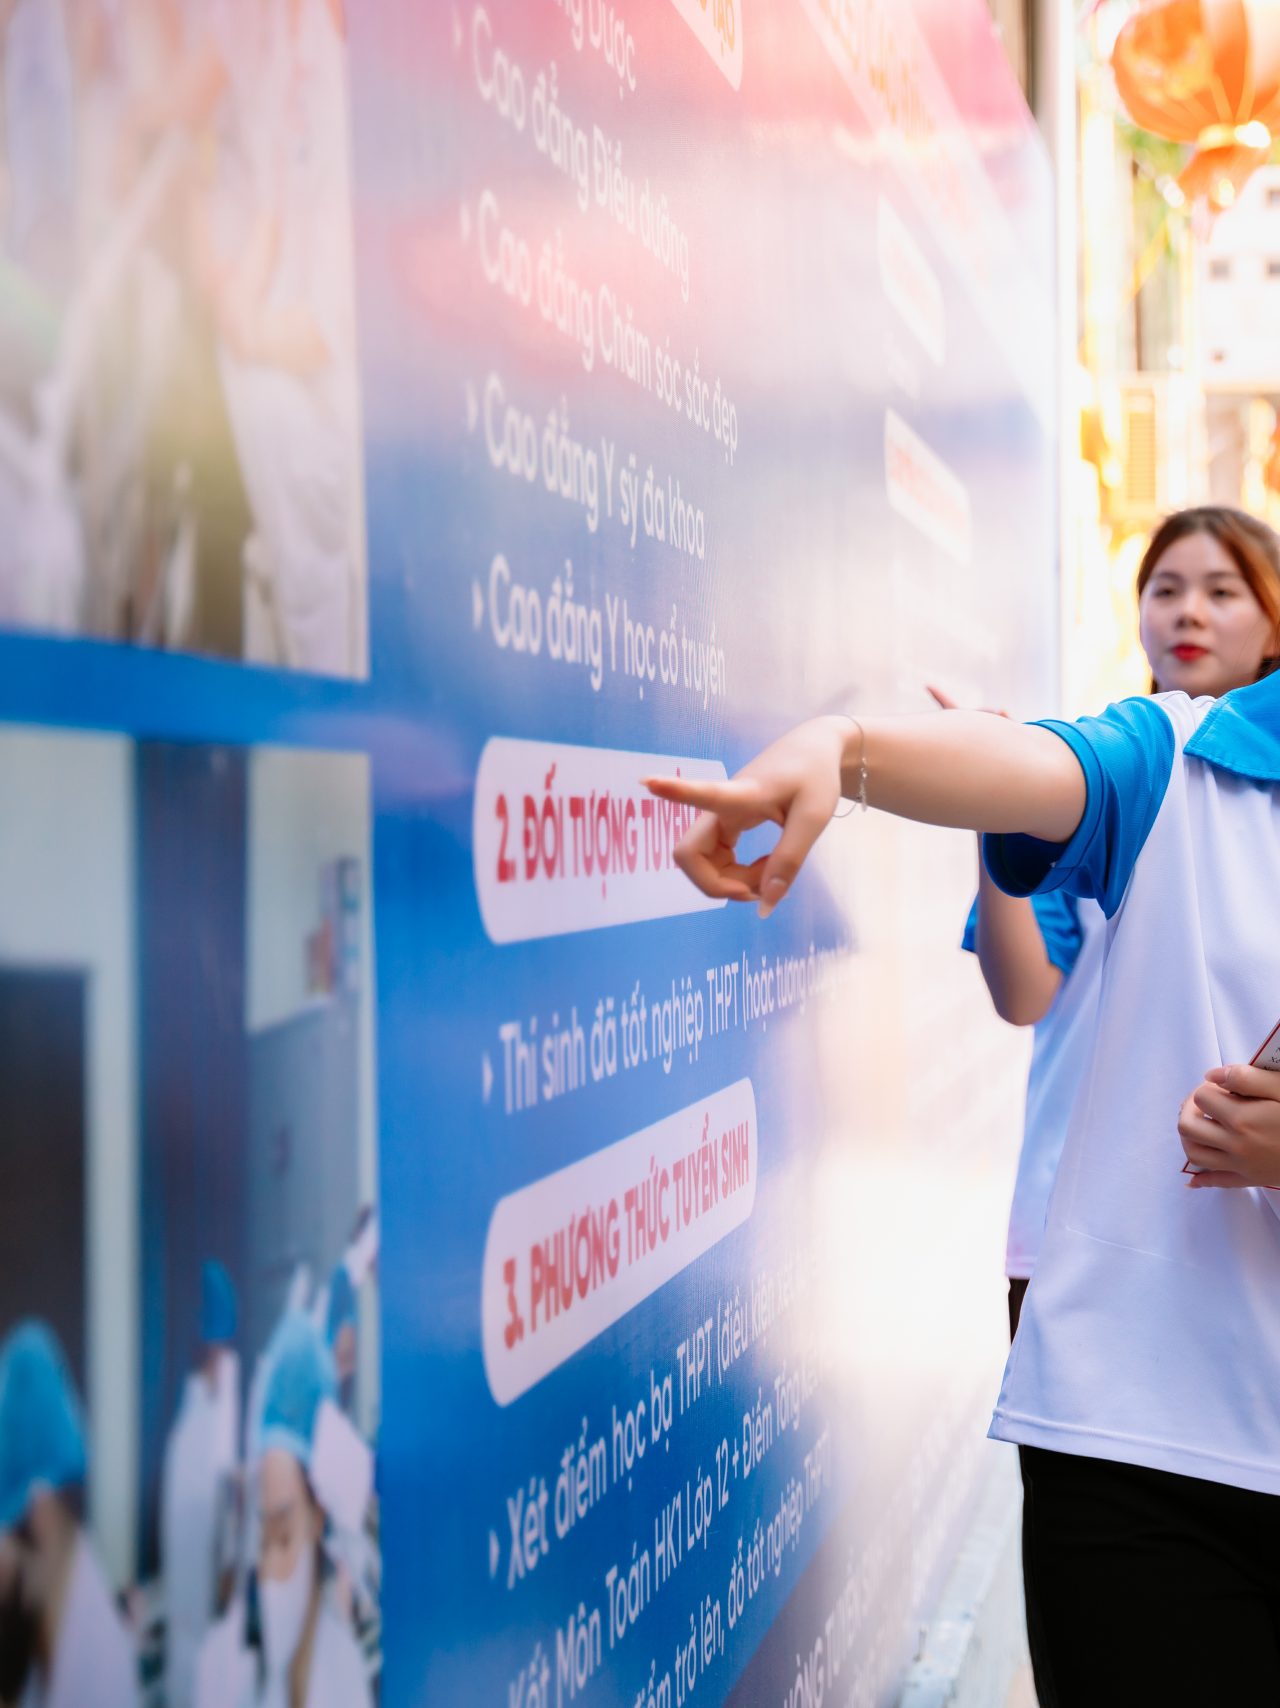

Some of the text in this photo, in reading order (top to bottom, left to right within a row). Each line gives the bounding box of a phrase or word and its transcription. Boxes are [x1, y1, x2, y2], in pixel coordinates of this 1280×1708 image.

[472, 5, 526, 132] Cao
[477, 187, 531, 308] Cao
[600, 283, 652, 392] Chăm
[655, 336, 682, 413] sóc
[685, 345, 710, 433] sắc
[713, 376, 738, 465] đẹp
[485, 370, 705, 560] Cao đẳng Y sỹ đa khoa
[489, 553, 726, 710] Cao đẳng Y học cổ truyền
[496, 793, 516, 882] 2.
[523, 763, 564, 880] ĐỐI
[569, 790, 637, 900] TƯỢNG
[499, 1016, 537, 1114] Thí
[542, 1005, 586, 1101] sinh
[590, 996, 617, 1082] đã
[620, 979, 648, 1070] tốt
[651, 975, 704, 1074] nghiệp
[706, 961, 739, 1036] THPT
[742, 950, 775, 1032] (hoặc
[530, 1198, 620, 1334] PHƯƠNG
[624, 1154, 670, 1266] THỨC
[672, 1111, 718, 1232] TUYỂN
[721, 1120, 749, 1199] SINH
[506, 1475, 549, 1591] Xét
[554, 1415, 606, 1540] điểm
[612, 1399, 646, 1492] học
[650, 1369, 673, 1452] bạ
[677, 1317, 713, 1416] THPT
[717, 1287, 749, 1385] (điều
[556, 1600, 602, 1708] Môn
[605, 1541, 650, 1649] Toán
[654, 1490, 682, 1592] HK1
[686, 1465, 713, 1550] Lớp
[715, 1438, 729, 1511] 12
[742, 1387, 773, 1479] Điểm
[675, 1612, 697, 1708] trở
[700, 1594, 725, 1674] lên,
[728, 1536, 745, 1630] đỗ
[747, 1517, 764, 1599] tốt
[767, 1478, 803, 1577] nghiệp
